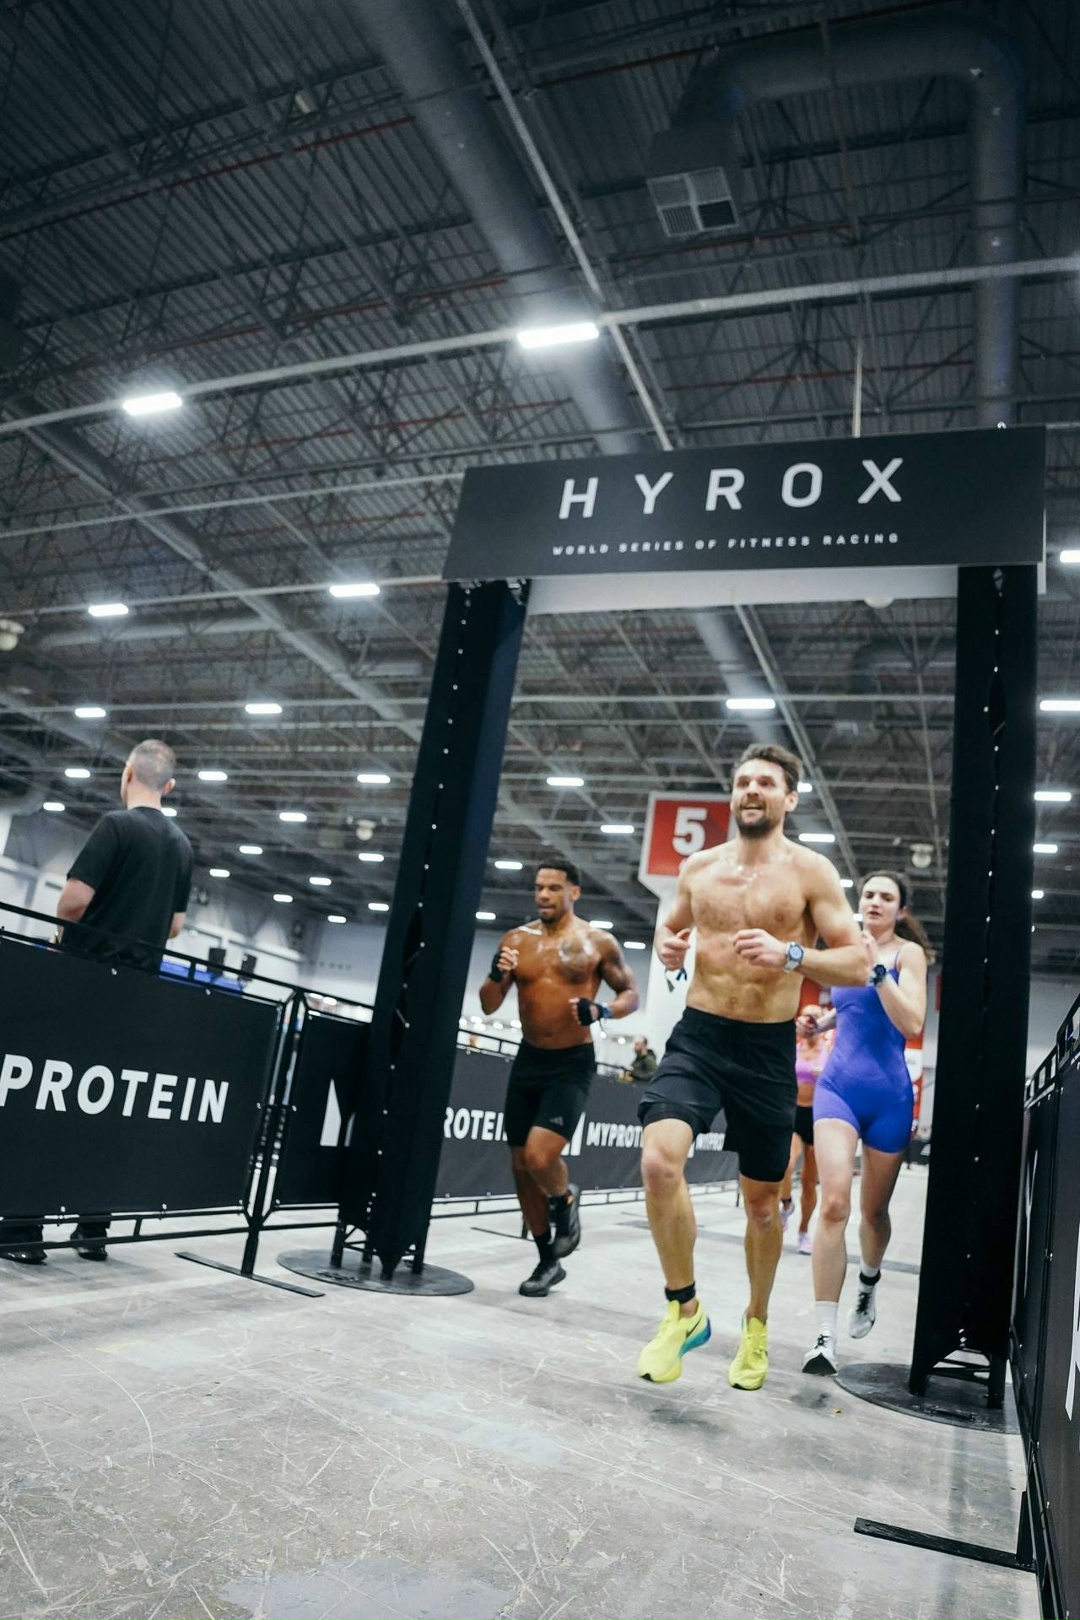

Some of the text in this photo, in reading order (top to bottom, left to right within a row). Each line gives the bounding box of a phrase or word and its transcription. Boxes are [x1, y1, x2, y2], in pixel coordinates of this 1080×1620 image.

[558, 458, 904, 520] HYROX
[552, 533, 899, 556] WORLD SERIES OF FITNESS RACING
[672, 807, 708, 856] 5
[443, 1106, 508, 1142] ROTEI
[586, 1121, 644, 1148] MYPROT
